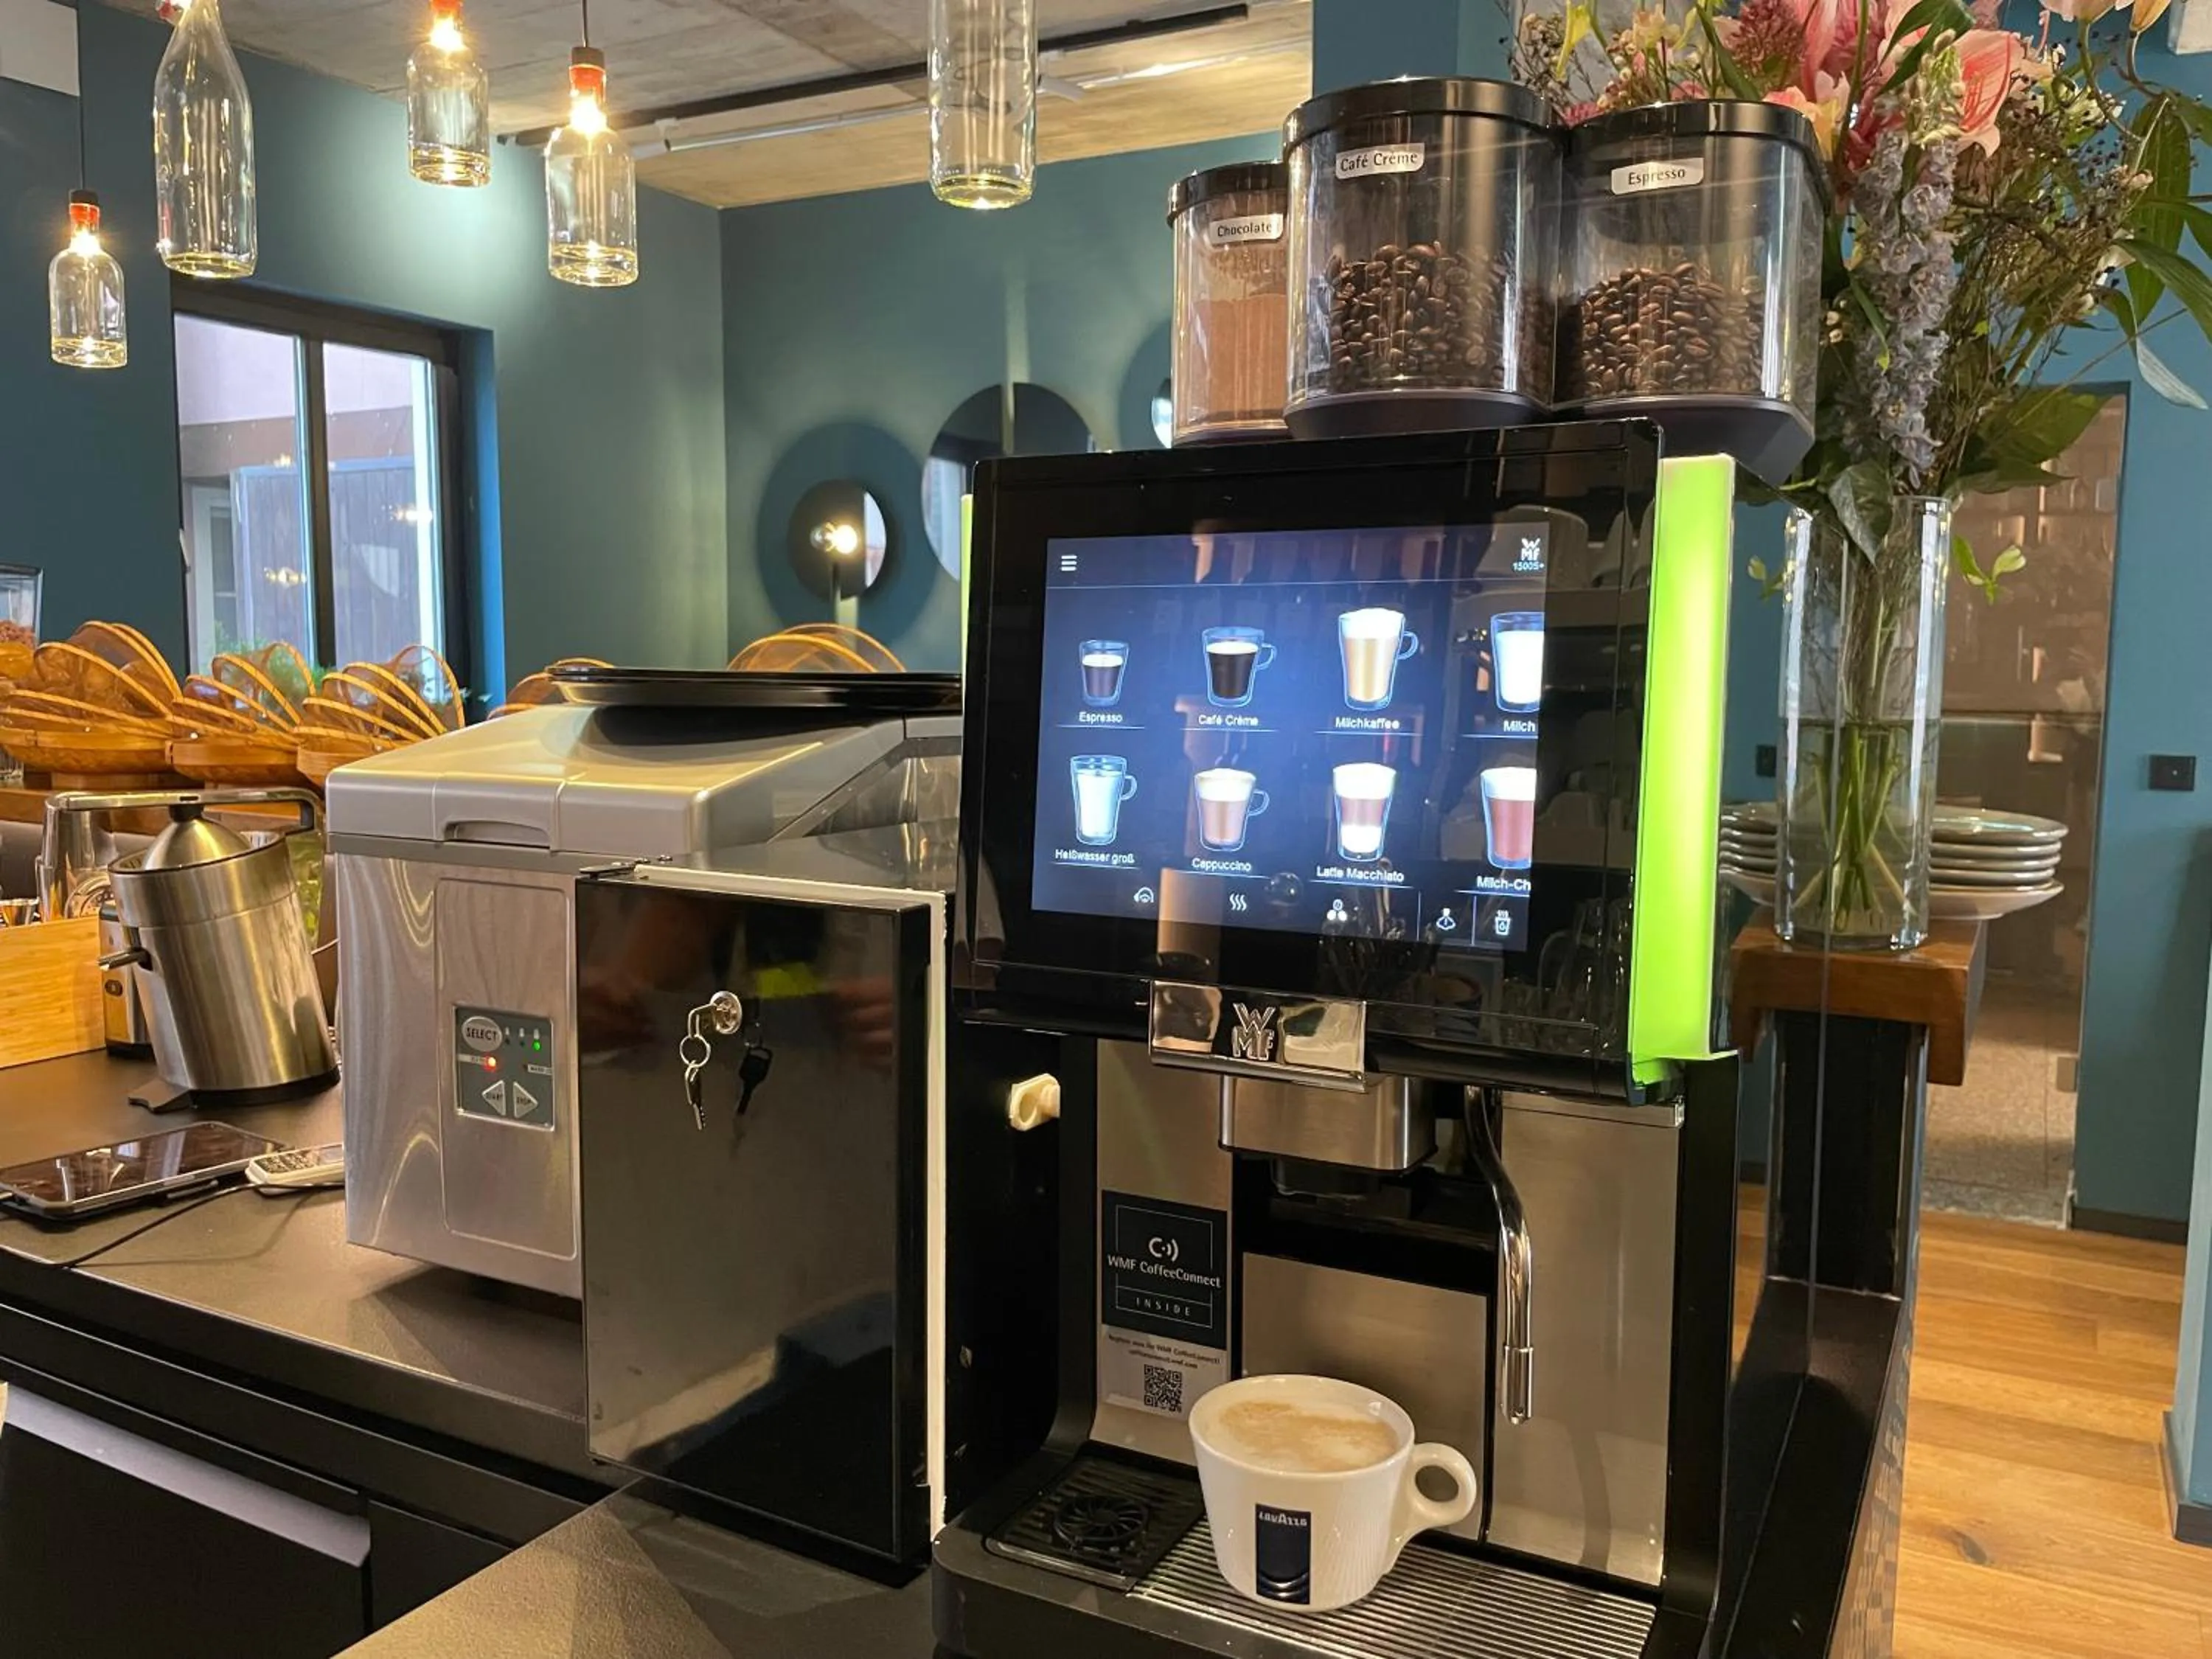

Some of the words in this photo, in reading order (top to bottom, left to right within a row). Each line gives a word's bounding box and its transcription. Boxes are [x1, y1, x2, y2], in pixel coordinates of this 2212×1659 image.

[1340, 153, 1368, 172] Café
[1628, 168, 1686, 186] Espresso
[1217, 222, 1272, 237] Chocolate
[1079, 711, 1123, 724] Espresso
[1198, 714, 1222, 726] Café
[1335, 716, 1400, 729] Milchkaffee
[1503, 720, 1536, 732] Milch
[1055, 849, 1110, 863] Heißwasser
[1112, 853, 1135, 865] groß
[1191, 857, 1251, 872] Cappuccino
[1316, 866, 1343, 877] Latte
[1346, 866, 1405, 883] Macchiato
[466, 1026, 498, 1043] SELECT
[1107, 1254, 1136, 1270] WMF
[1139, 1261, 1221, 1288] CoffeeConnect
[1135, 1297, 1190, 1316] INSIDE
[1259, 1511, 1307, 1527] LAVAZZA
